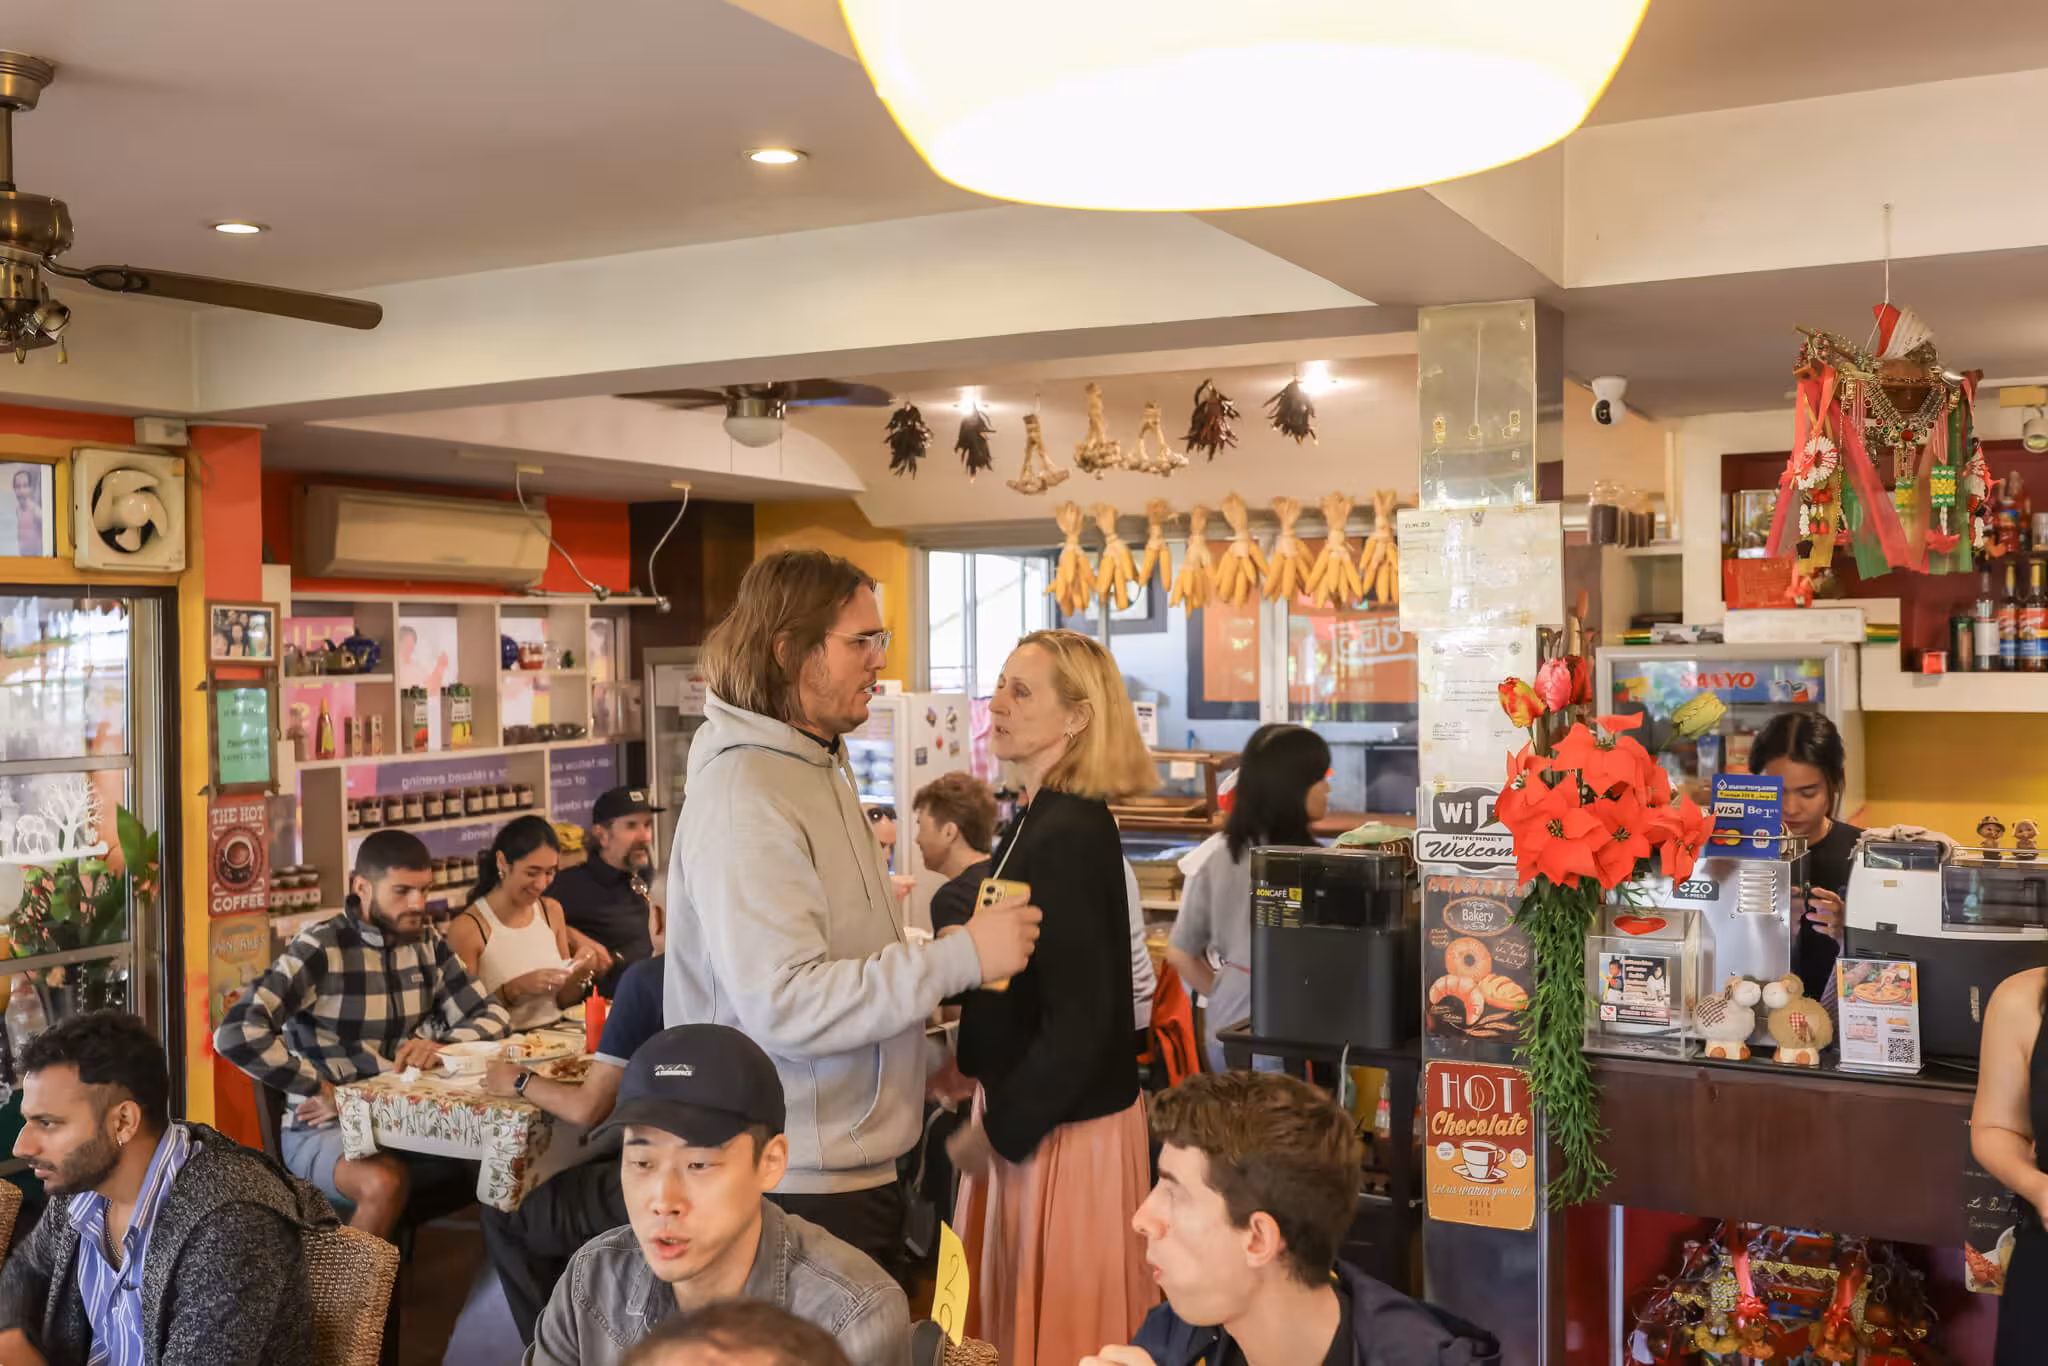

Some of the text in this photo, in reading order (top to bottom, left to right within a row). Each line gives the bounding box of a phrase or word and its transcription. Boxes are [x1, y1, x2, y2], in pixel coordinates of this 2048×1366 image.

[1679, 672, 1756, 690] SANYO
[211, 805, 265, 825] THE HOT
[1717, 806, 1743, 815] VISA
[1451, 834, 1504, 843] INTERNET
[1424, 839, 1515, 859] Welcom
[211, 893, 266, 912] COFFEE
[1461, 908, 1494, 923] Bakery
[1439, 1072, 1518, 1114] HOT
[1431, 1110, 1529, 1137] Chocolate
[1431, 1183, 1446, 1193] Let
[1446, 1184, 1457, 1193] us
[1458, 1184, 1491, 1196] warm
[1491, 1185, 1507, 1200] you
